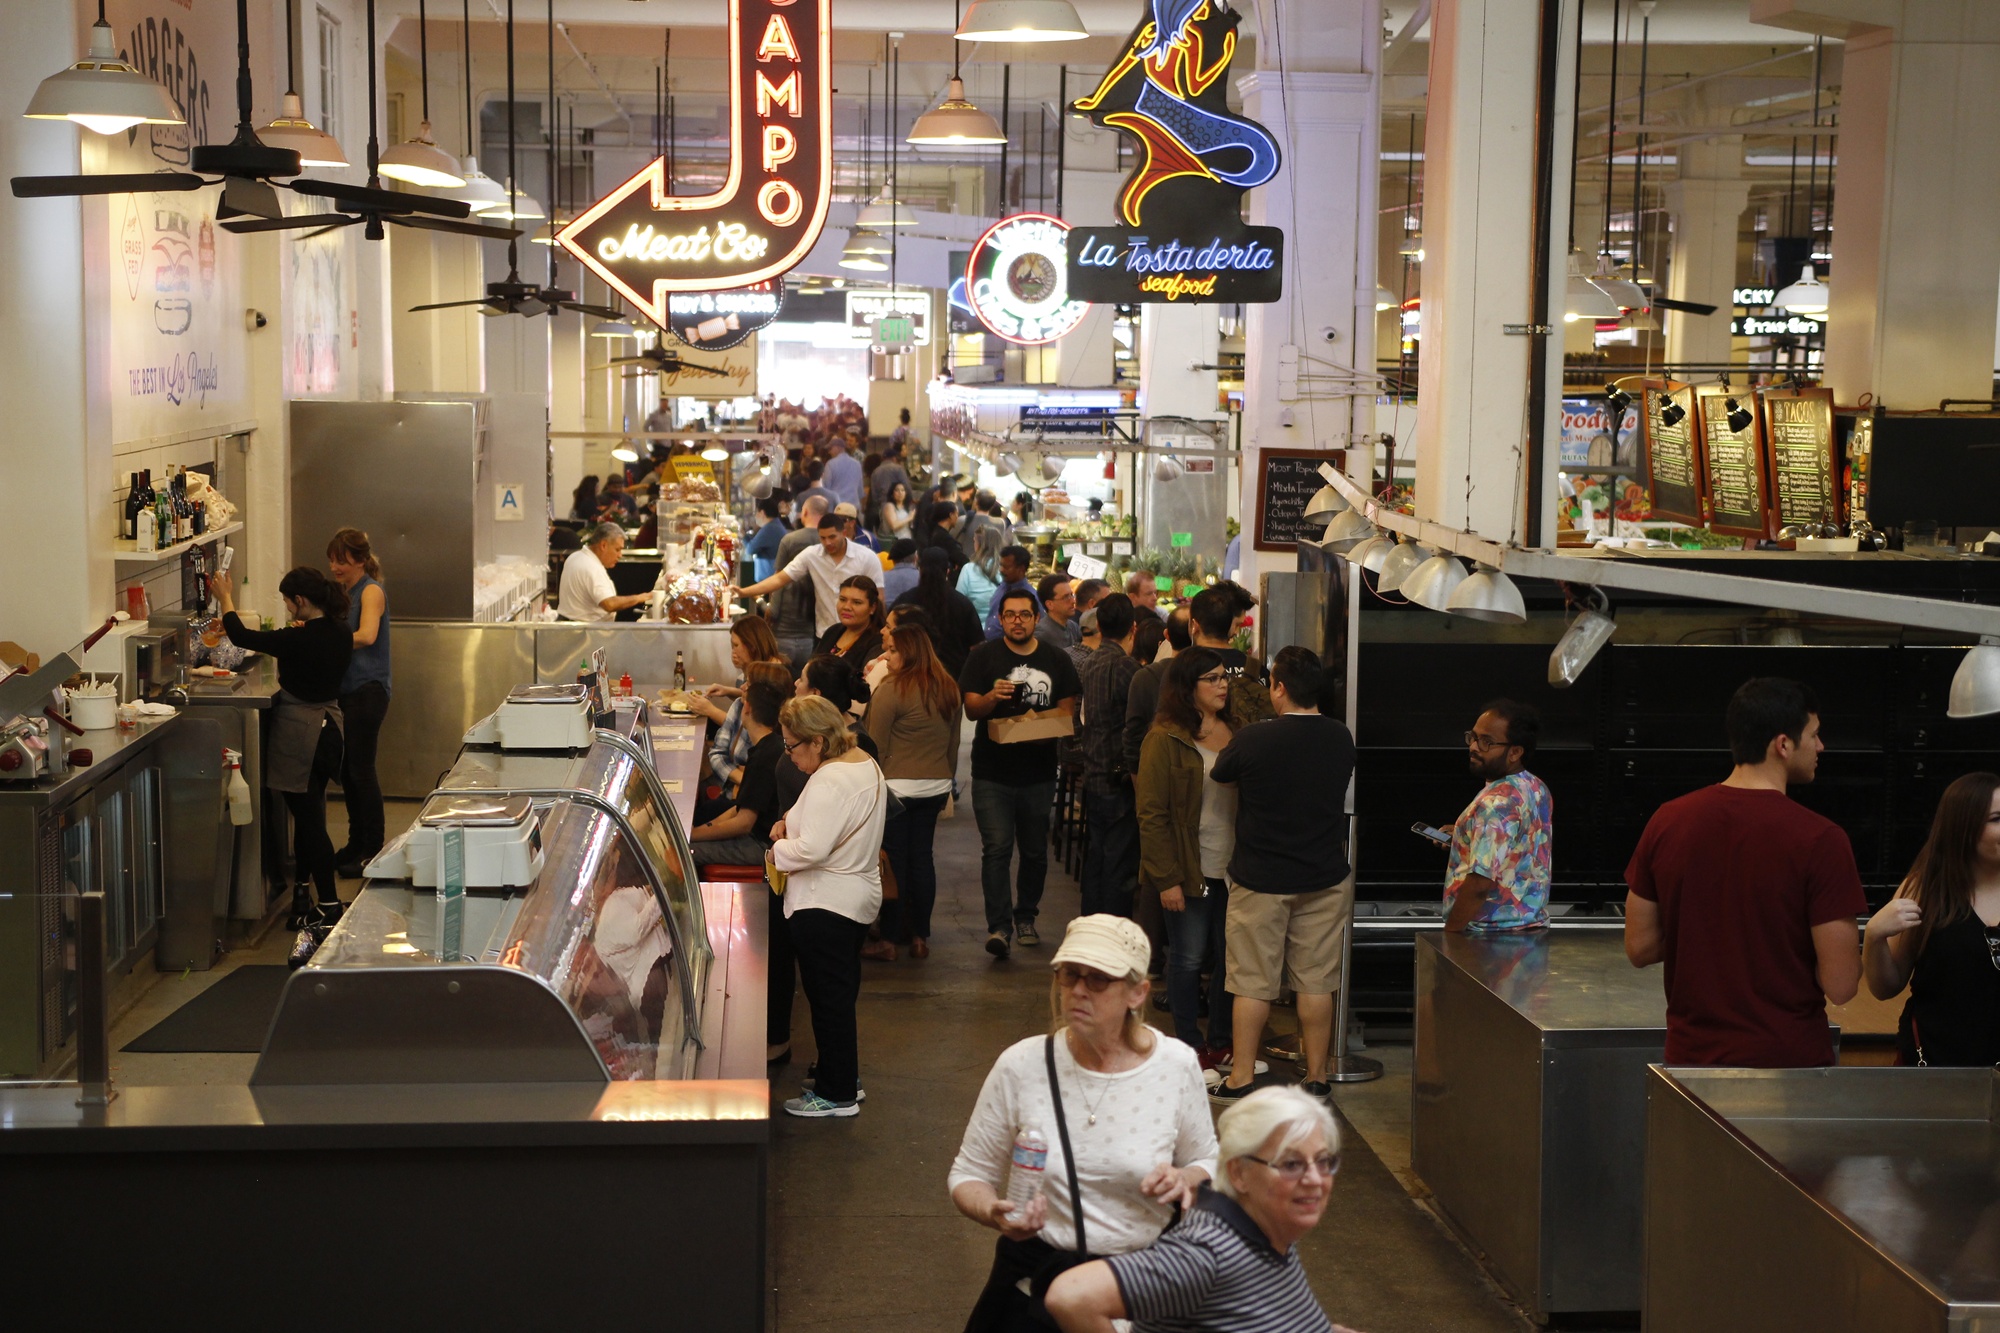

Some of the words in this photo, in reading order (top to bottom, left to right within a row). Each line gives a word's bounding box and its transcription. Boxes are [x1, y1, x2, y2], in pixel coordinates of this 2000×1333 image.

[119, 16, 209, 147] URGERS
[755, 0, 803, 227] AMPO
[125, 240, 142, 254] GRASS
[598, 223, 711, 262] Meat
[1078, 235, 1117, 267] La
[1126, 235, 1275, 273] Tostadería
[129, 260, 139, 274] FED
[1139, 272, 1218, 301] seafood
[880, 319, 909, 341] EXIT
[129, 369, 141, 396] THE
[142, 367, 157, 394] BEST
[159, 366, 165, 393] IN
[167, 353, 184, 406] Los
[187, 351, 218, 410] Angeles
[1783, 400, 1815, 423] TACOS
[501, 489, 518, 508] A
